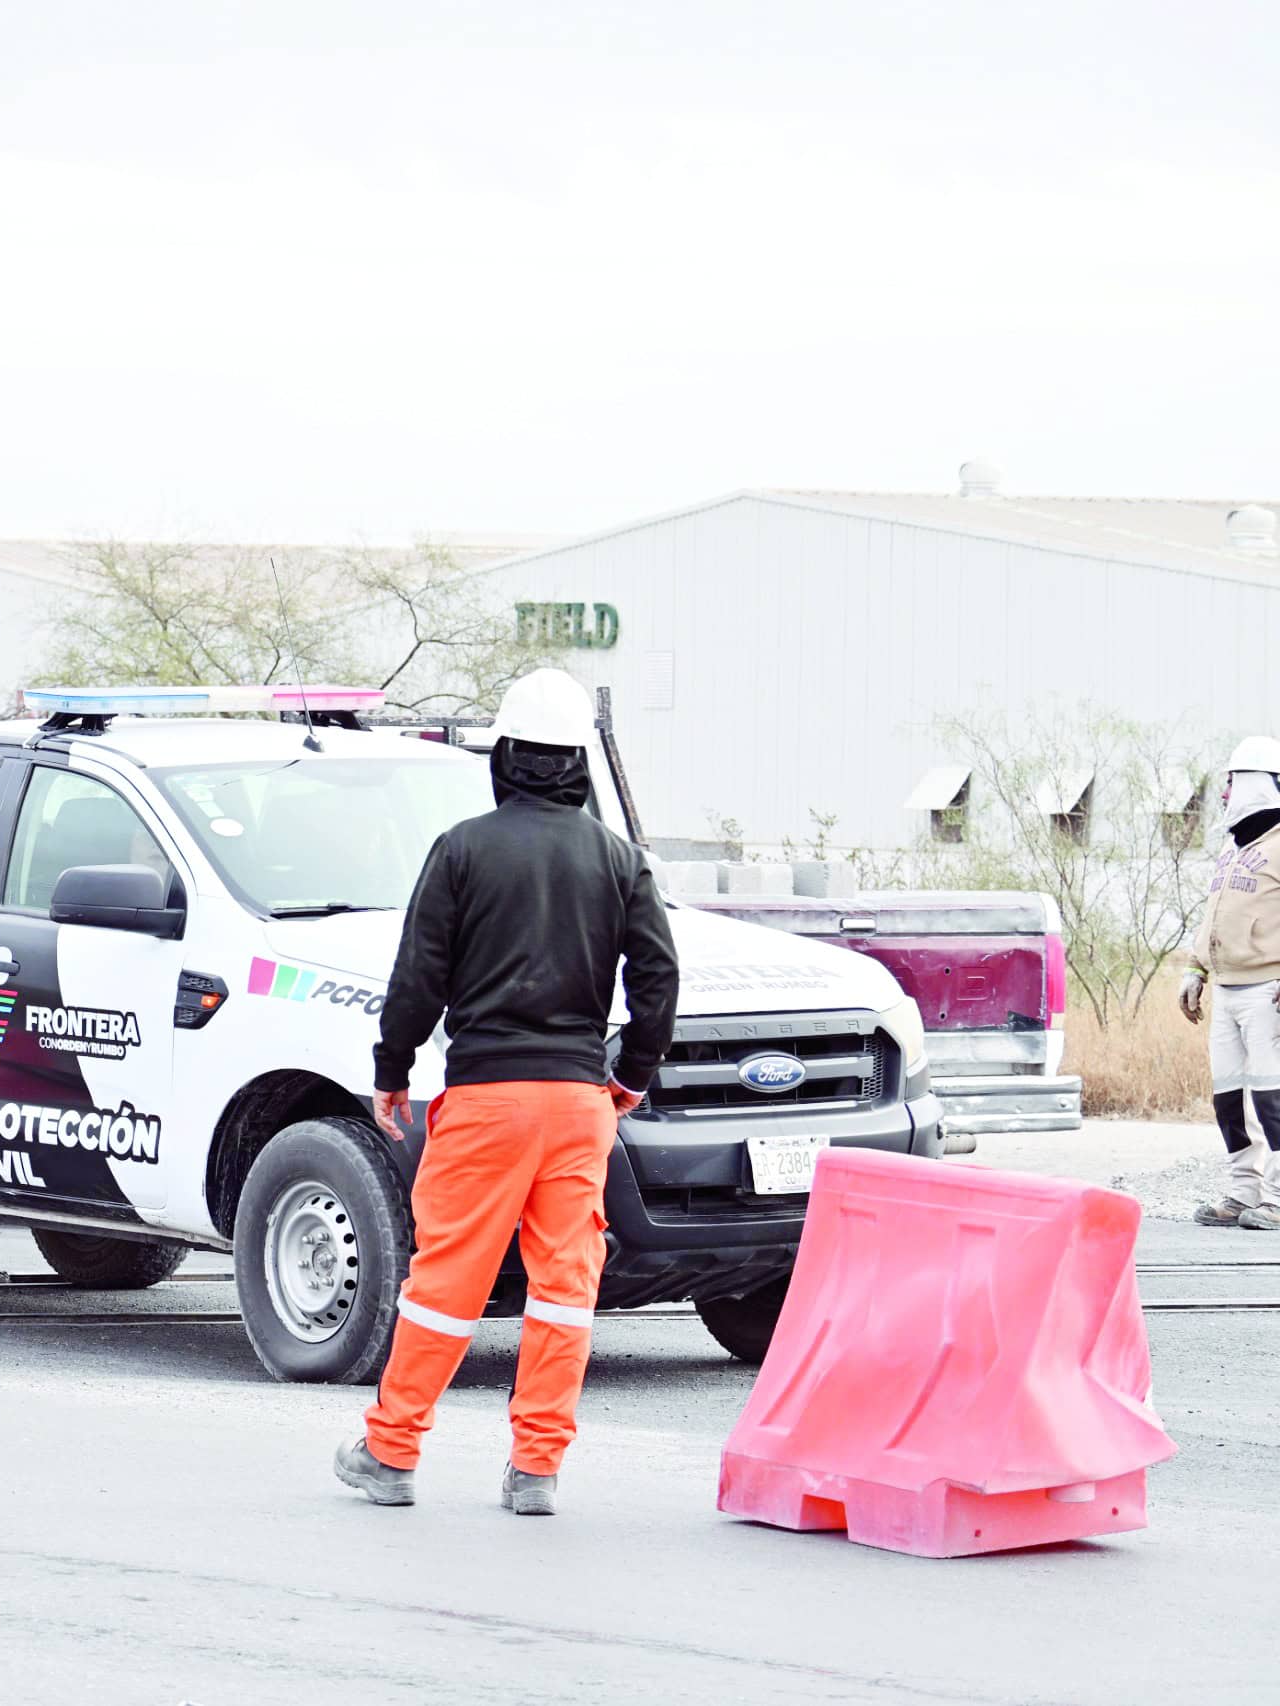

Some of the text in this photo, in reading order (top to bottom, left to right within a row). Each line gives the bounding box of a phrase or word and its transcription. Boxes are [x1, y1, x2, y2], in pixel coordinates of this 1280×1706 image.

[515, 603, 619, 649] FIELD
[310, 980, 386, 1015] PCF0
[25, 1005, 140, 1043] FRONTERA
[758, 1062, 793, 1082] Ford
